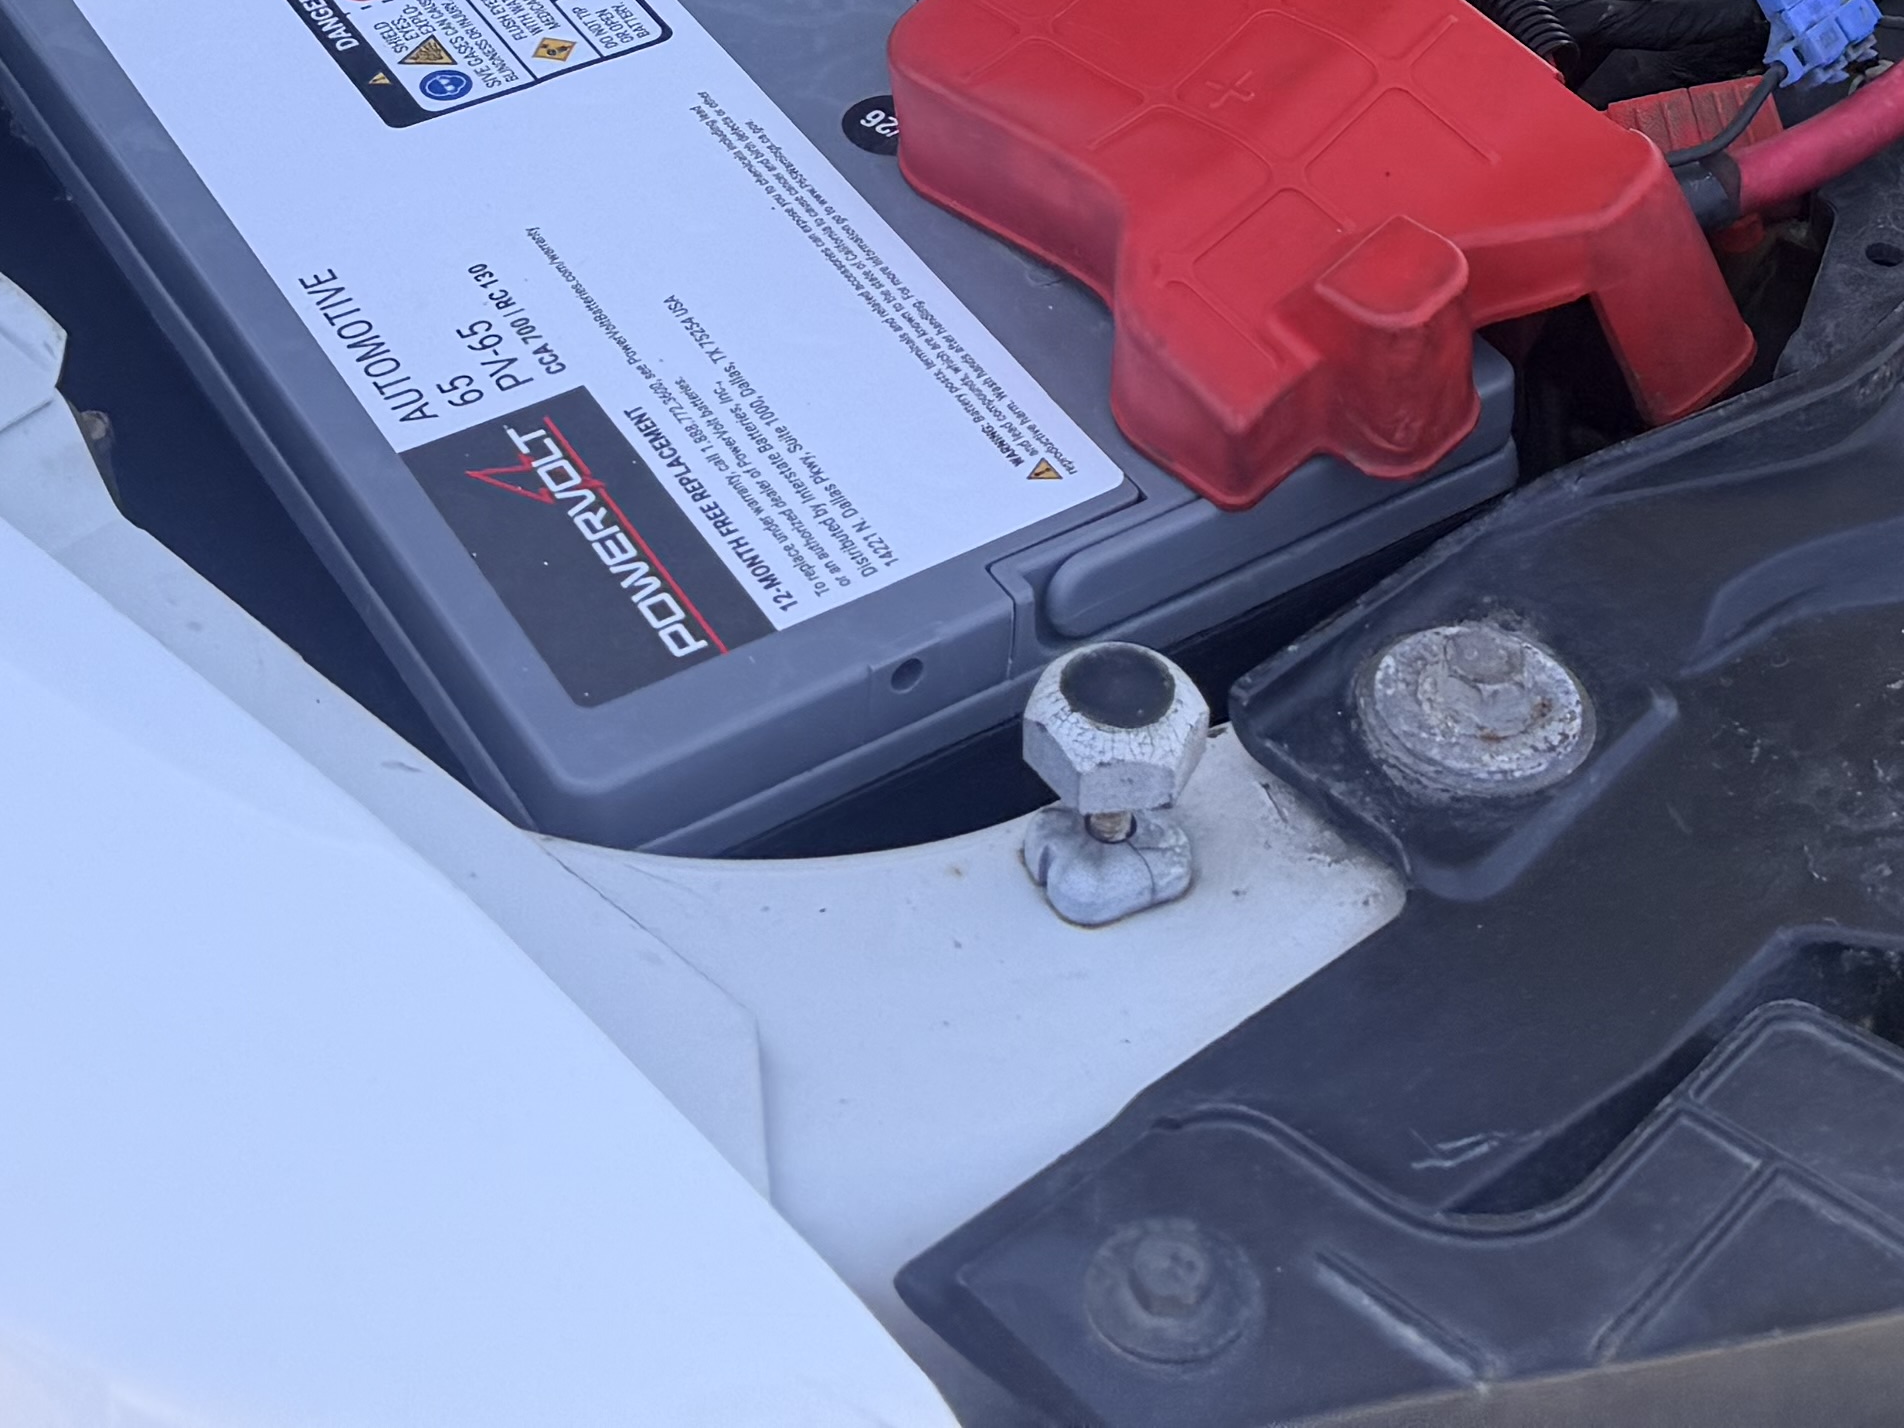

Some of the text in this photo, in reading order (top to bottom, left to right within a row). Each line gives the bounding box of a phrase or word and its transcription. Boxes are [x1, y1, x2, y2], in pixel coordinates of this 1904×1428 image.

[372, 20, 409, 54] SHIELD
[389, 13, 421, 42] EYES.
[401, 2, 437, 36] EXPLO-
[434, 16, 459, 37] CAN
[463, 25, 483, 40] OR
[495, 12, 528, 41] FLUSH
[515, 11, 544, 37] WITH
[570, 5, 619, 50] DO NOT TIP
[593, 7, 635, 44] OR OPEN
[609, 0, 651, 39] BATTERY.
[447, 34, 484, 67] GASES
[473, 37, 520, 83] BLINDNESS
[472, 64, 502, 89] SIVE
[466, 262, 567, 375] CCA 700 RC 130
[297, 267, 439, 423] AUTOMOTIVE
[454, 319, 534, 392] PV-65
[634, 362, 656, 380] see
[434, 373, 484, 407] 65
[662, 293, 899, 567] 14221 N. Dallas Pkwy, Suite 1000, Dallas, TX 75254 USA
[728, 402, 774, 454] Batteries,
[704, 451, 730, 472] call
[766, 450, 816, 505] Interstate
[673, 375, 851, 587] or an authorized dealer of PowerVolt batteries.
[724, 470, 765, 517] warranty,
[622, 405, 798, 612] 12-MONTH FREE REPLACEMENT
[808, 501, 829, 520] by
[505, 427, 709, 658] POWERVOLT
[757, 514, 789, 544] under
[816, 515, 879, 578] Distributed
[781, 542, 820, 582] replace
[813, 580, 830, 598] To
